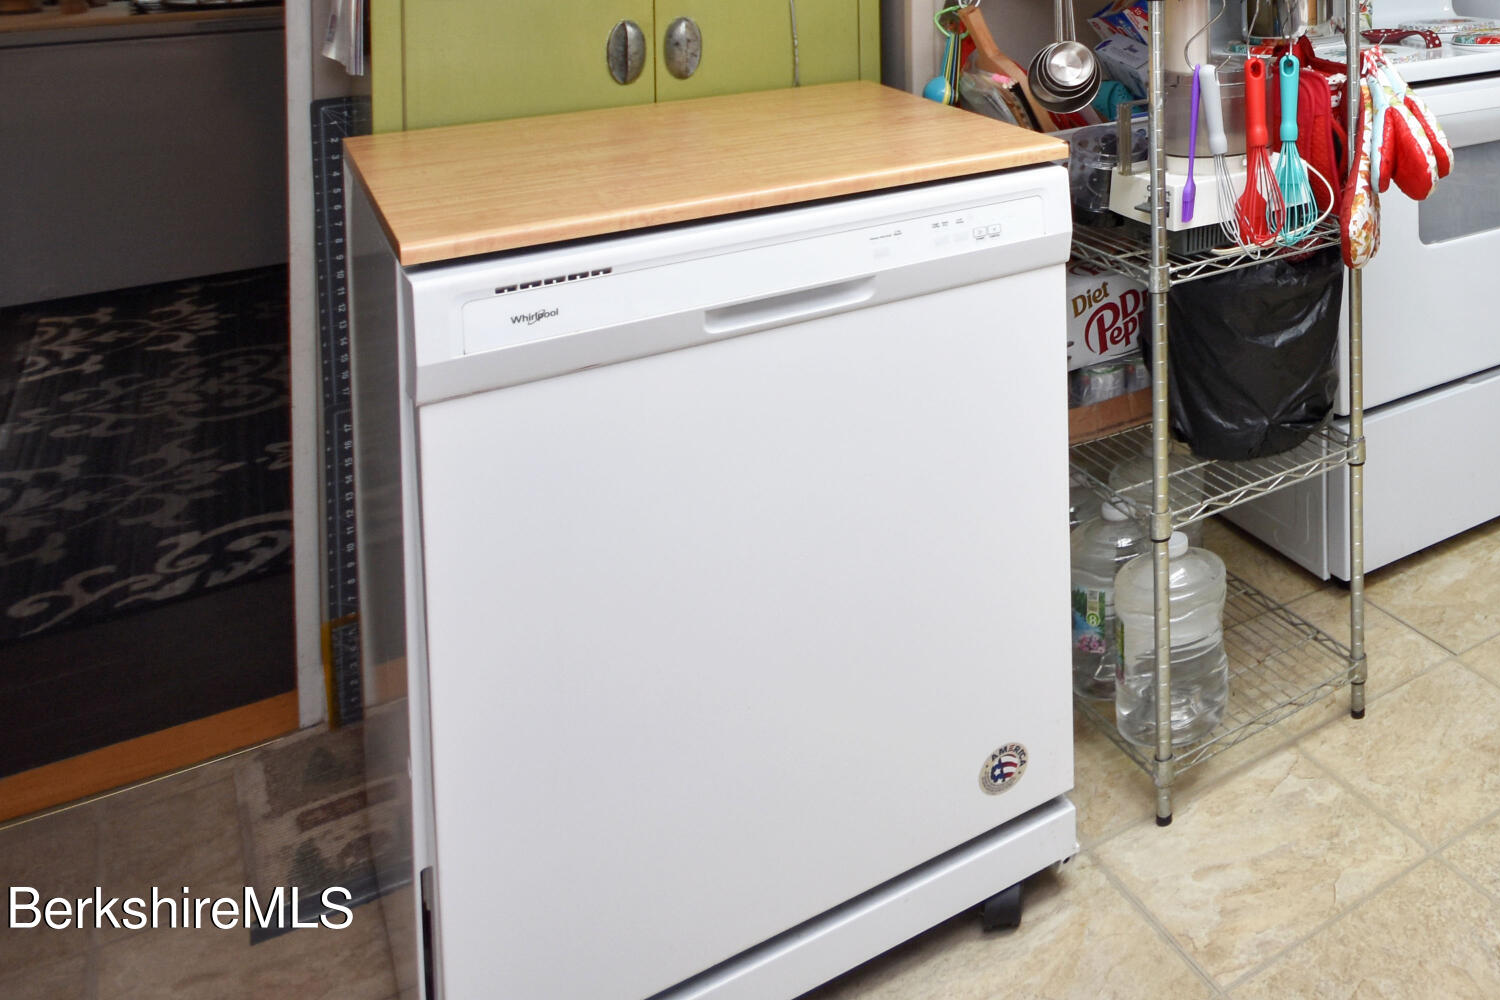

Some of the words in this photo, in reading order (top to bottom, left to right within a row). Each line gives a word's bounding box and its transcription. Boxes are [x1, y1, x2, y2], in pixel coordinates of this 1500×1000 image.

[510, 308, 559, 325] Whirlpool
[1071, 281, 1110, 318] Diet
[1084, 301, 1145, 356] Pep
